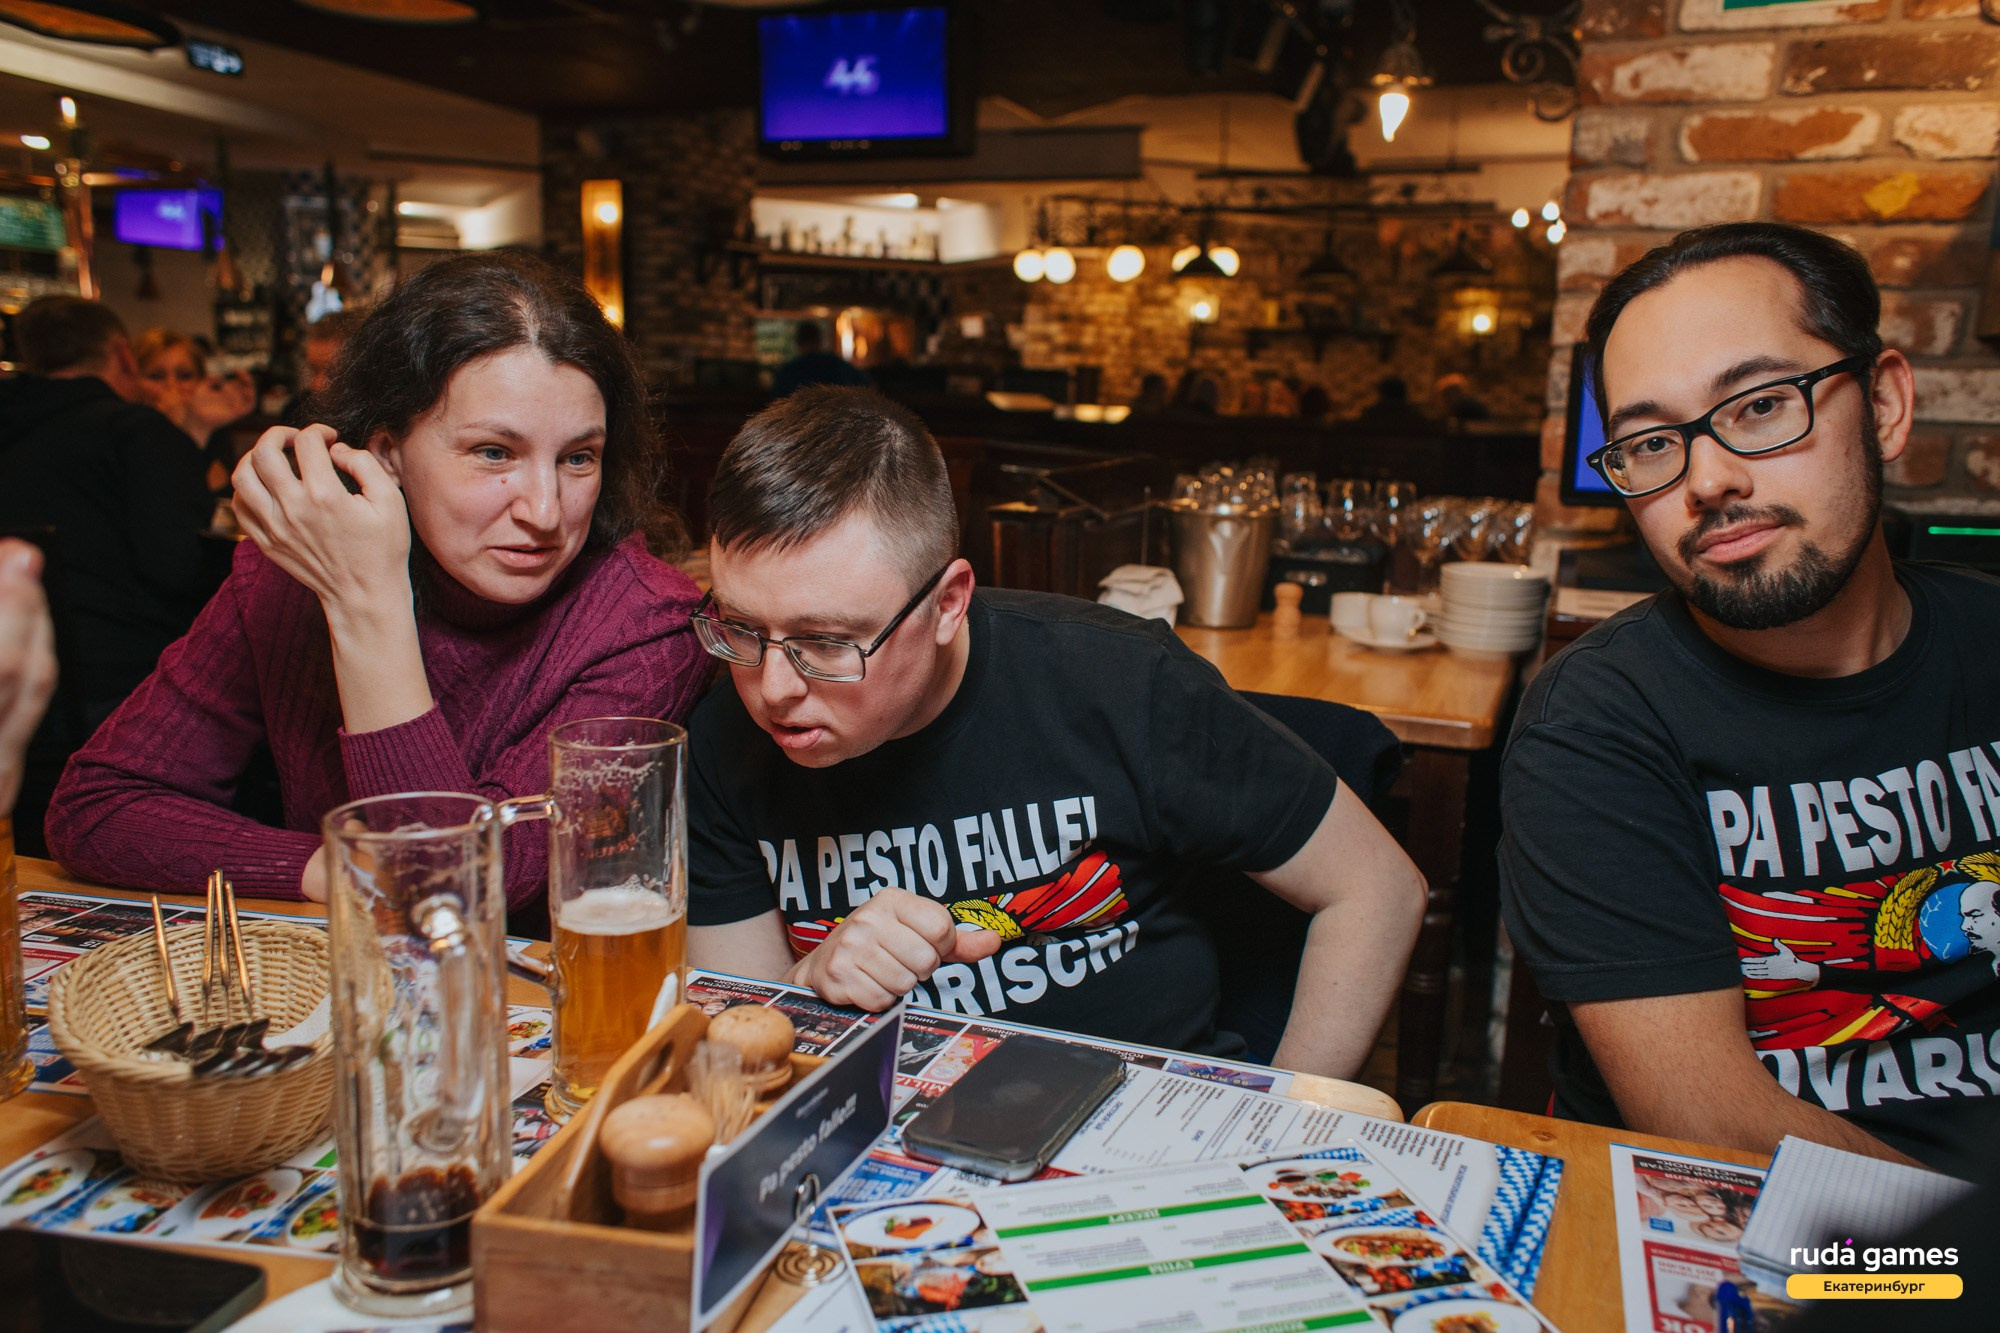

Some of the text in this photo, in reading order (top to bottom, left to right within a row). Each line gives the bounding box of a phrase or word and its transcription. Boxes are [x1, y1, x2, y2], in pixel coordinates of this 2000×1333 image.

[1706, 740, 2000, 878] PA PESTO FA
[817, 823, 949, 910] PESTO
[794, 1044, 815, 1055] 15
[1639, 1160, 1758, 1187] ЗОЛОТОЙ СОСТАВ
[1664, 1172, 1719, 1187] АПРЕЛЯ
